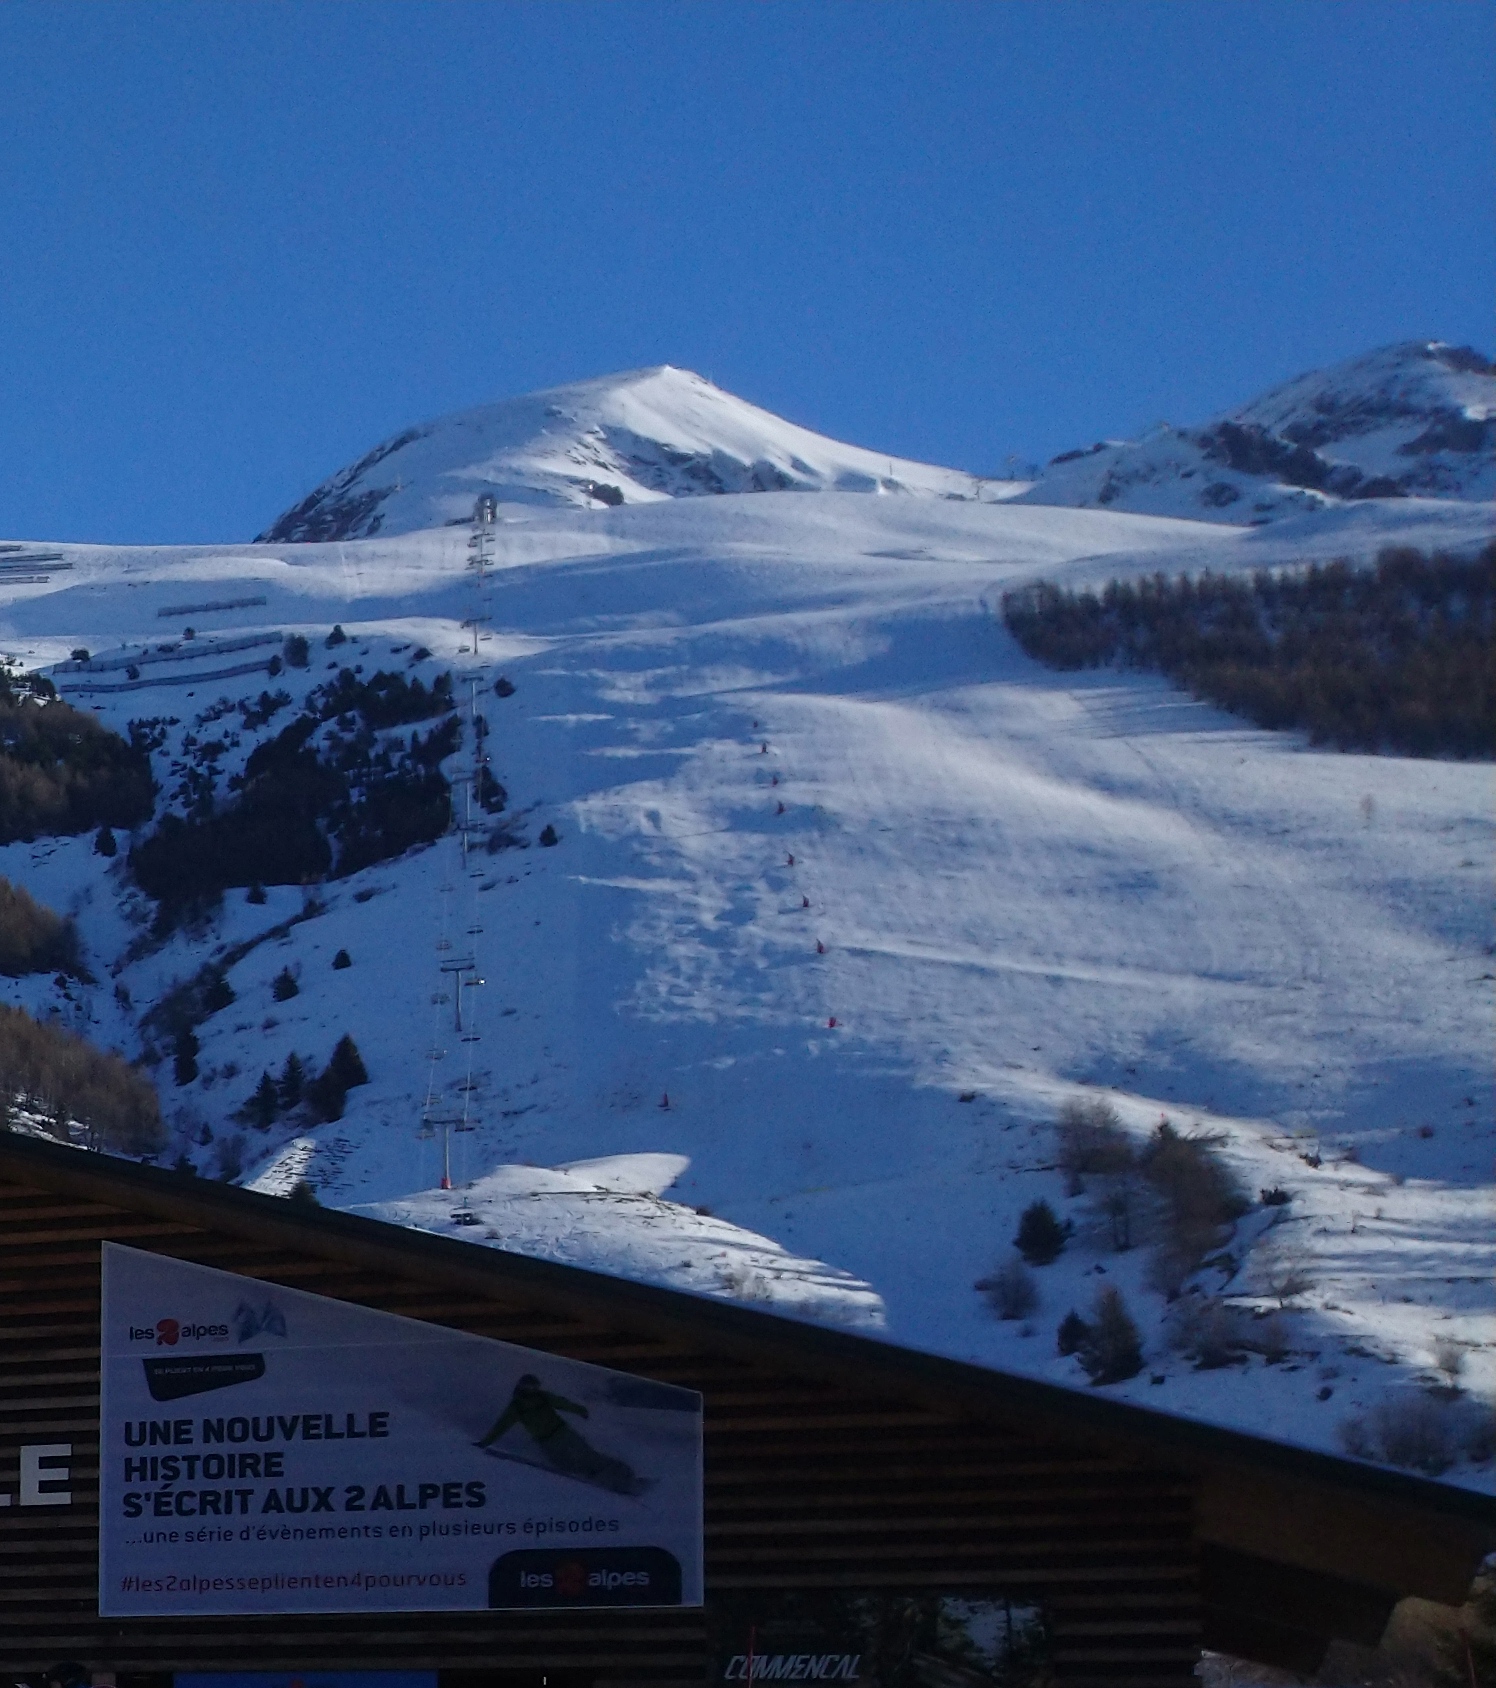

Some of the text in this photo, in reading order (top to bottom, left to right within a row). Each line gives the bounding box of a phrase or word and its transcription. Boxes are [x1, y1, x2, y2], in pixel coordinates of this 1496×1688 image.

[129, 1325, 155, 1342] les
[181, 1321, 229, 1341] alpes
[124, 1412, 390, 1447] UNE NOUVELLE
[123, 1451, 285, 1483] HISTOIRE
[122, 1483, 254, 1518] S'ÉCRIT
[261, 1487, 335, 1514] AUX
[184, 1526, 234, 1542] série
[239, 1523, 383, 1542] d'évènements
[388, 1525, 414, 1538] en
[419, 1519, 517, 1542] plusieurs
[522, 1516, 620, 1538] épisodes
[519, 1570, 553, 1588] les
[587, 1568, 650, 1590] alpes
[724, 1654, 862, 1680] COMMENCAL
